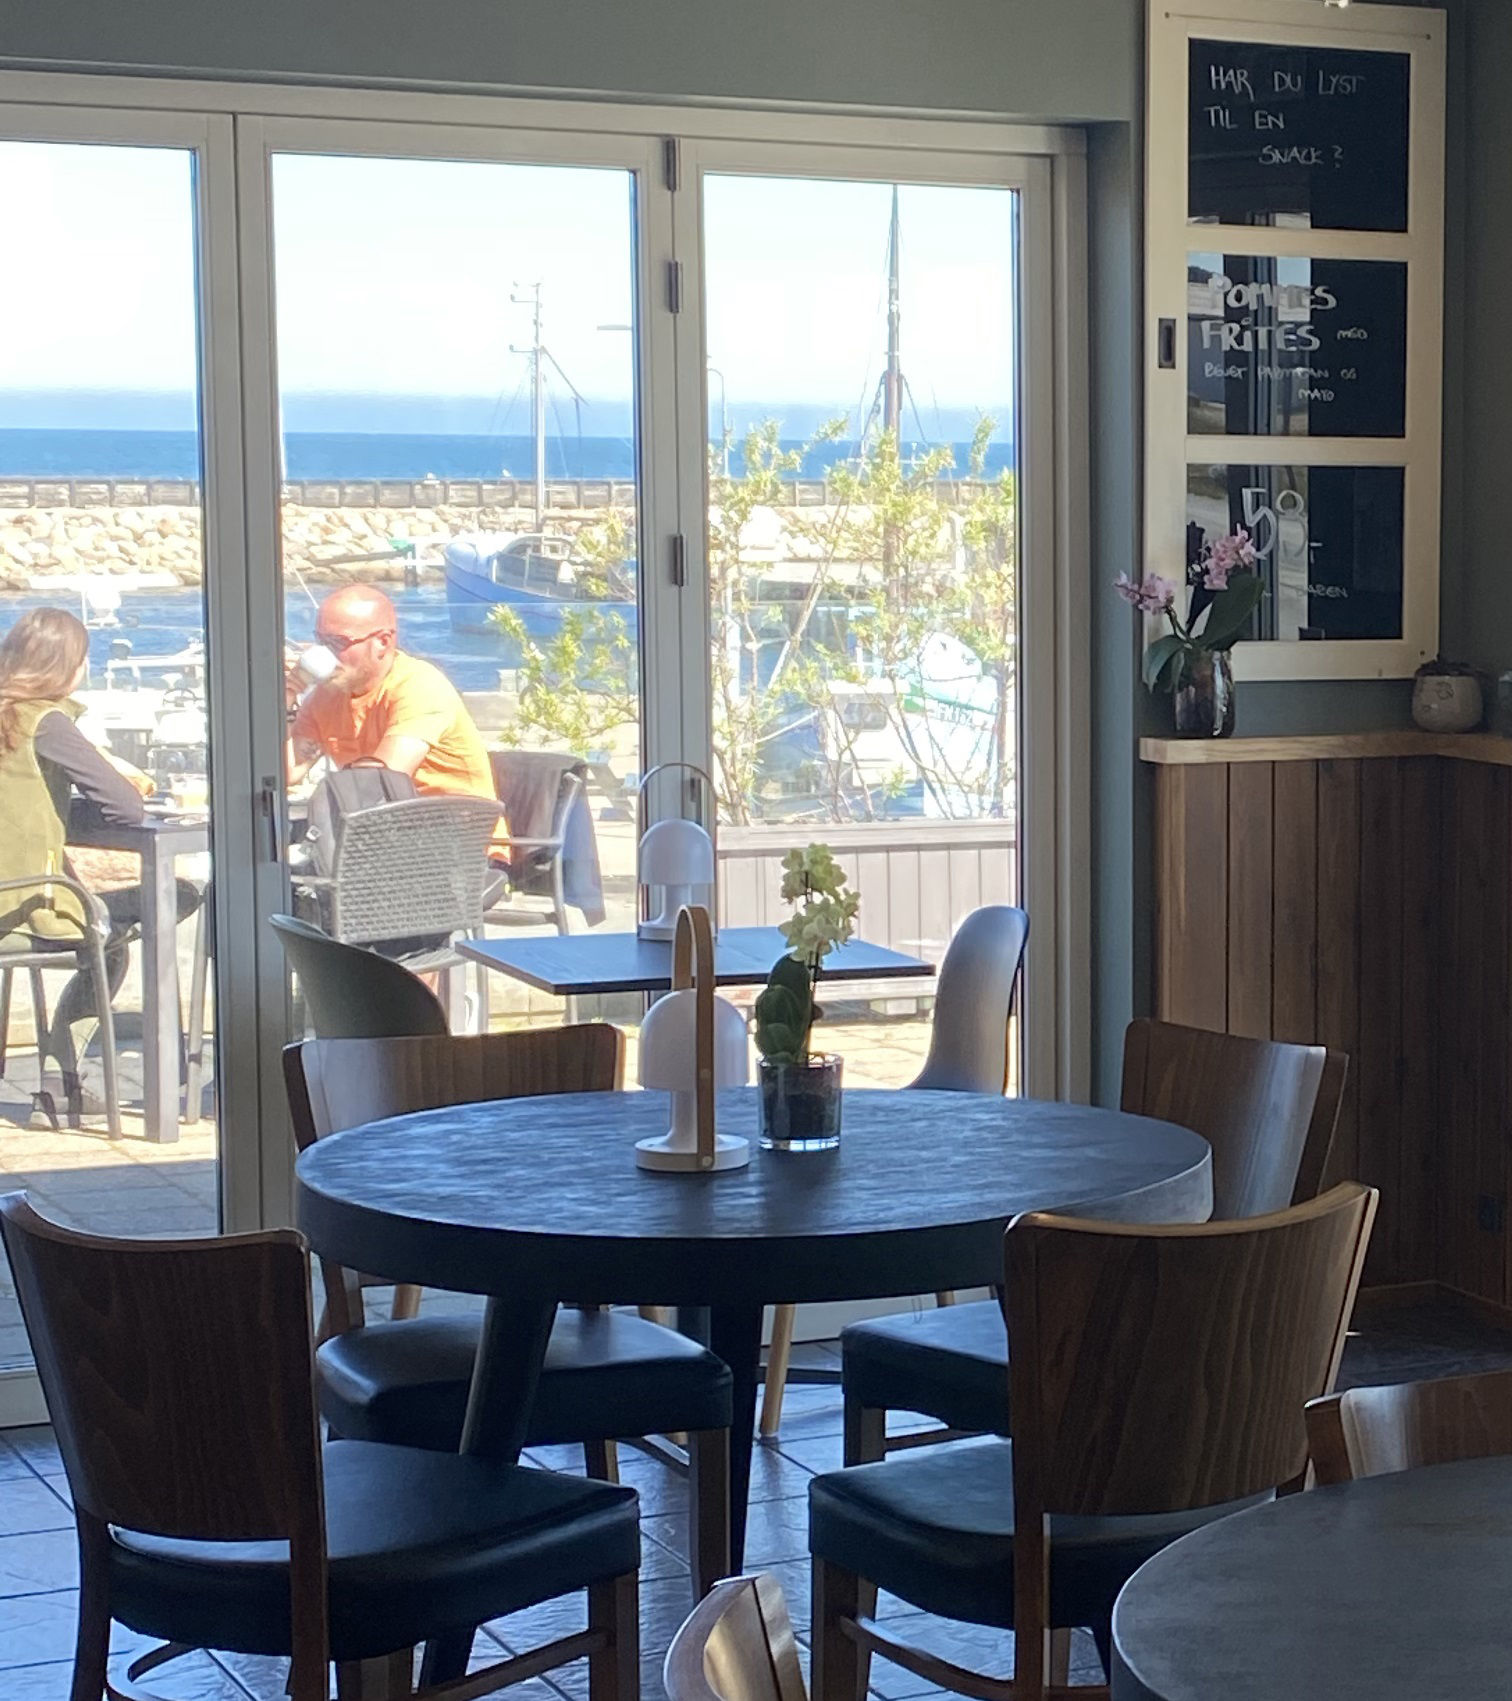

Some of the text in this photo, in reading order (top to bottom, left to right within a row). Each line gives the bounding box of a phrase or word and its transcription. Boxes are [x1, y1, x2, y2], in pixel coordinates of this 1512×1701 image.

[1210, 64, 1366, 102] HAR DU LYST
[1203, 106, 1284, 129] TIL EN
[1340, 367, 1357, 380] OG
[1298, 388, 1334, 402] MAYO
